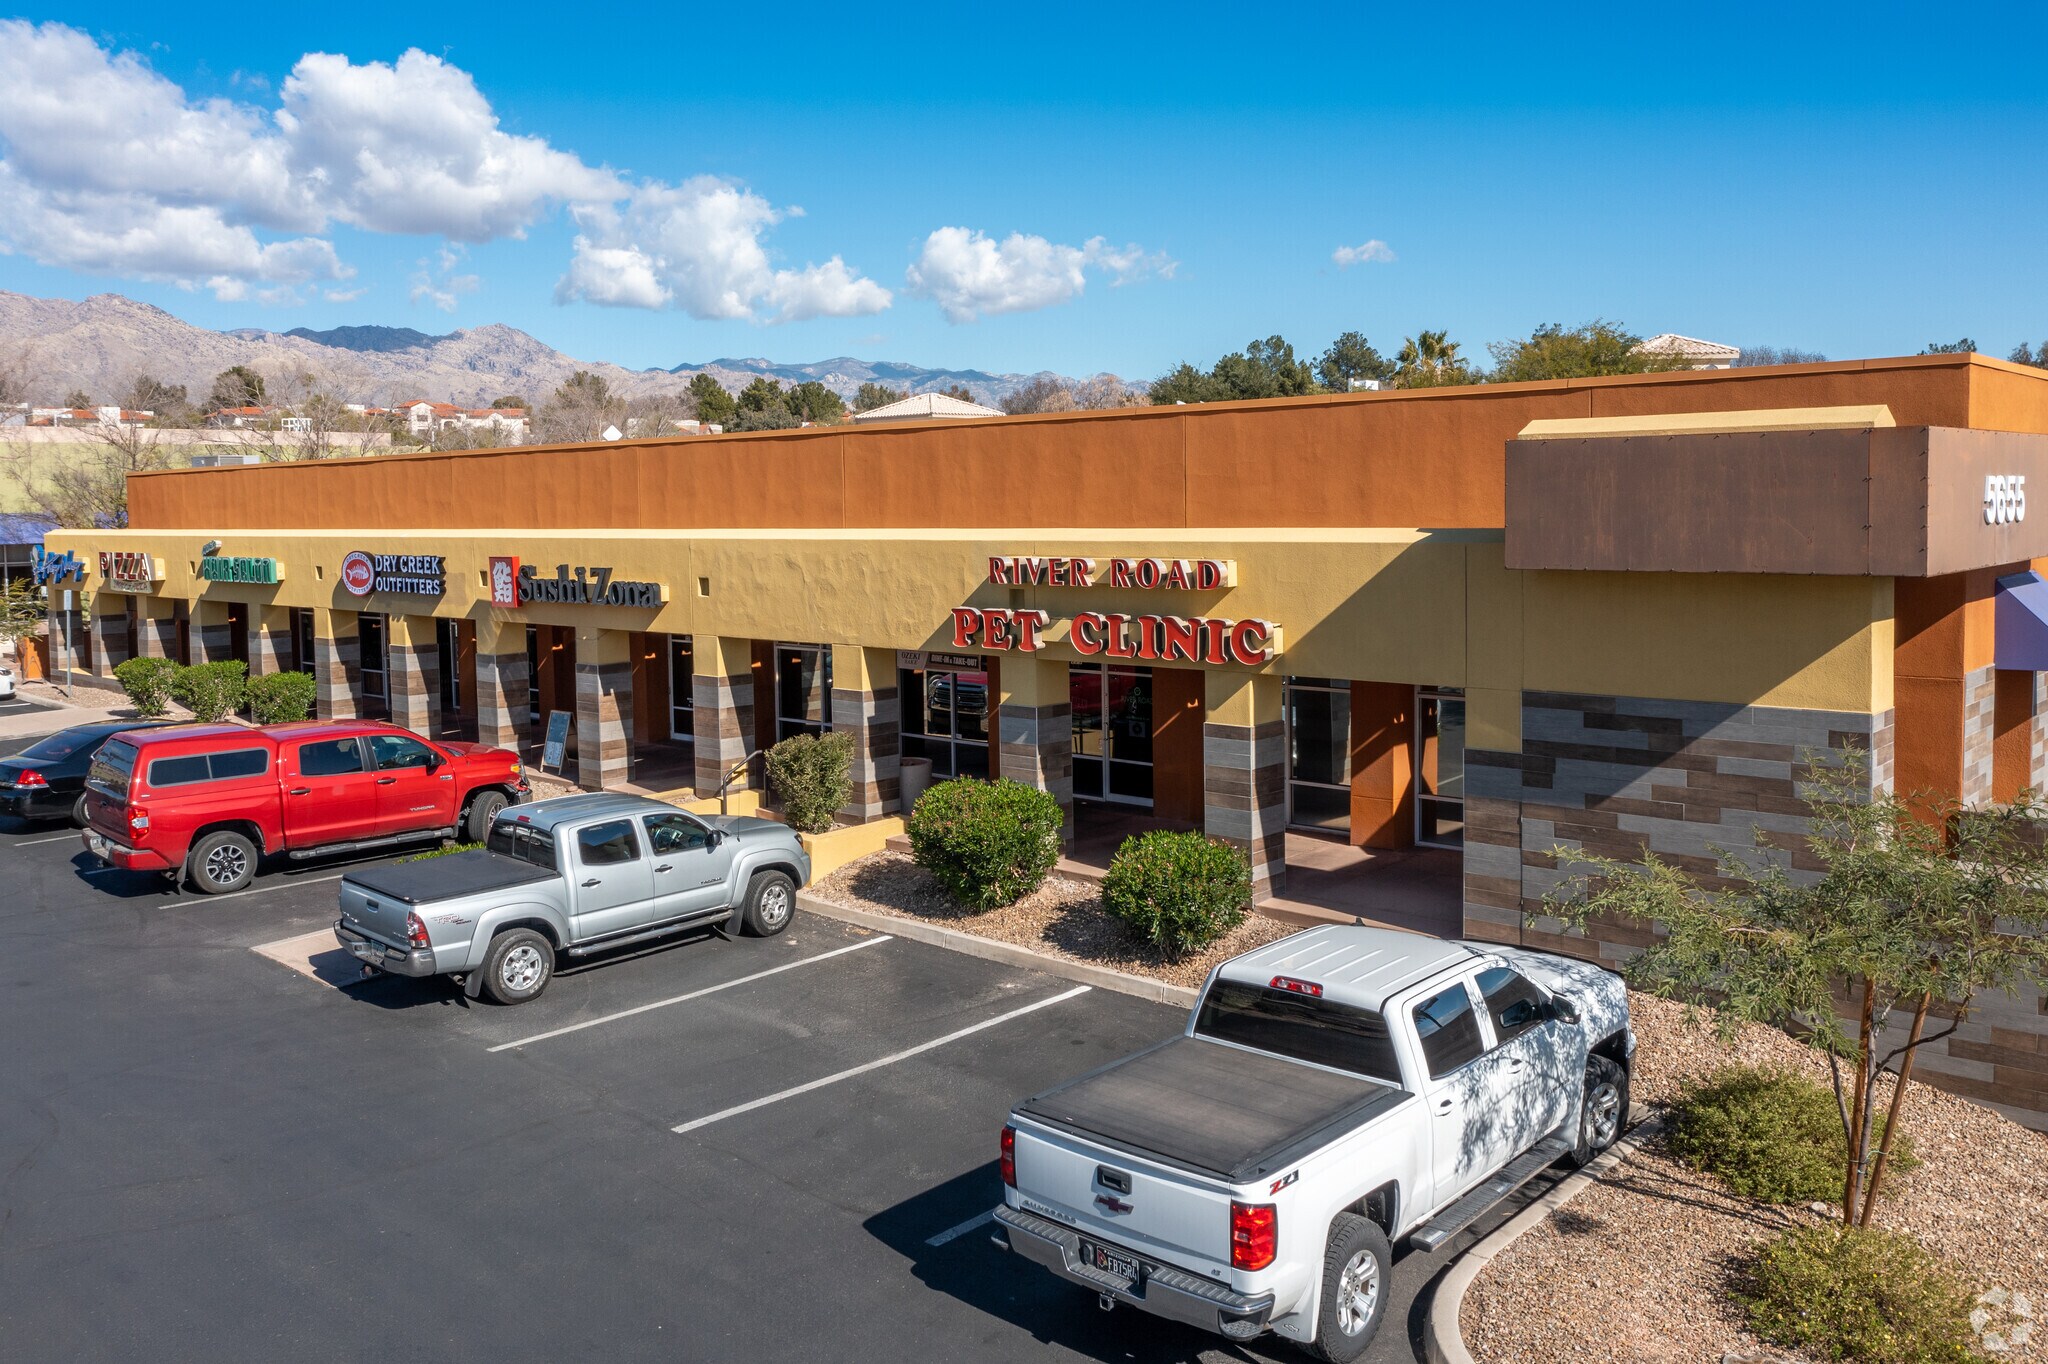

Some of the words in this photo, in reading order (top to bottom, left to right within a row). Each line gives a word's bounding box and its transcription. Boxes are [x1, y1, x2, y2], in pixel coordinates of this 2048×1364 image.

[1984, 475, 2026, 525] 5655
[99, 551, 151, 580] PIZZA
[203, 556, 233, 582] HAIR
[233, 557, 277, 584] SALON
[375, 555, 397, 573] DRY
[400, 555, 441, 574] CREEK
[988, 556, 1096, 587] RIVER
[1110, 558, 1228, 590] ROAD
[376, 576, 441, 595] OUTFITTERS
[518, 564, 587, 604] Sushi
[590, 567, 664, 608] Zona
[951, 607, 1049, 652] PET
[1070, 611, 1274, 666] CLINIC
[953, 656, 977, 667] TAKE-OUT
[1270, 1169, 1299, 1196] Z71
